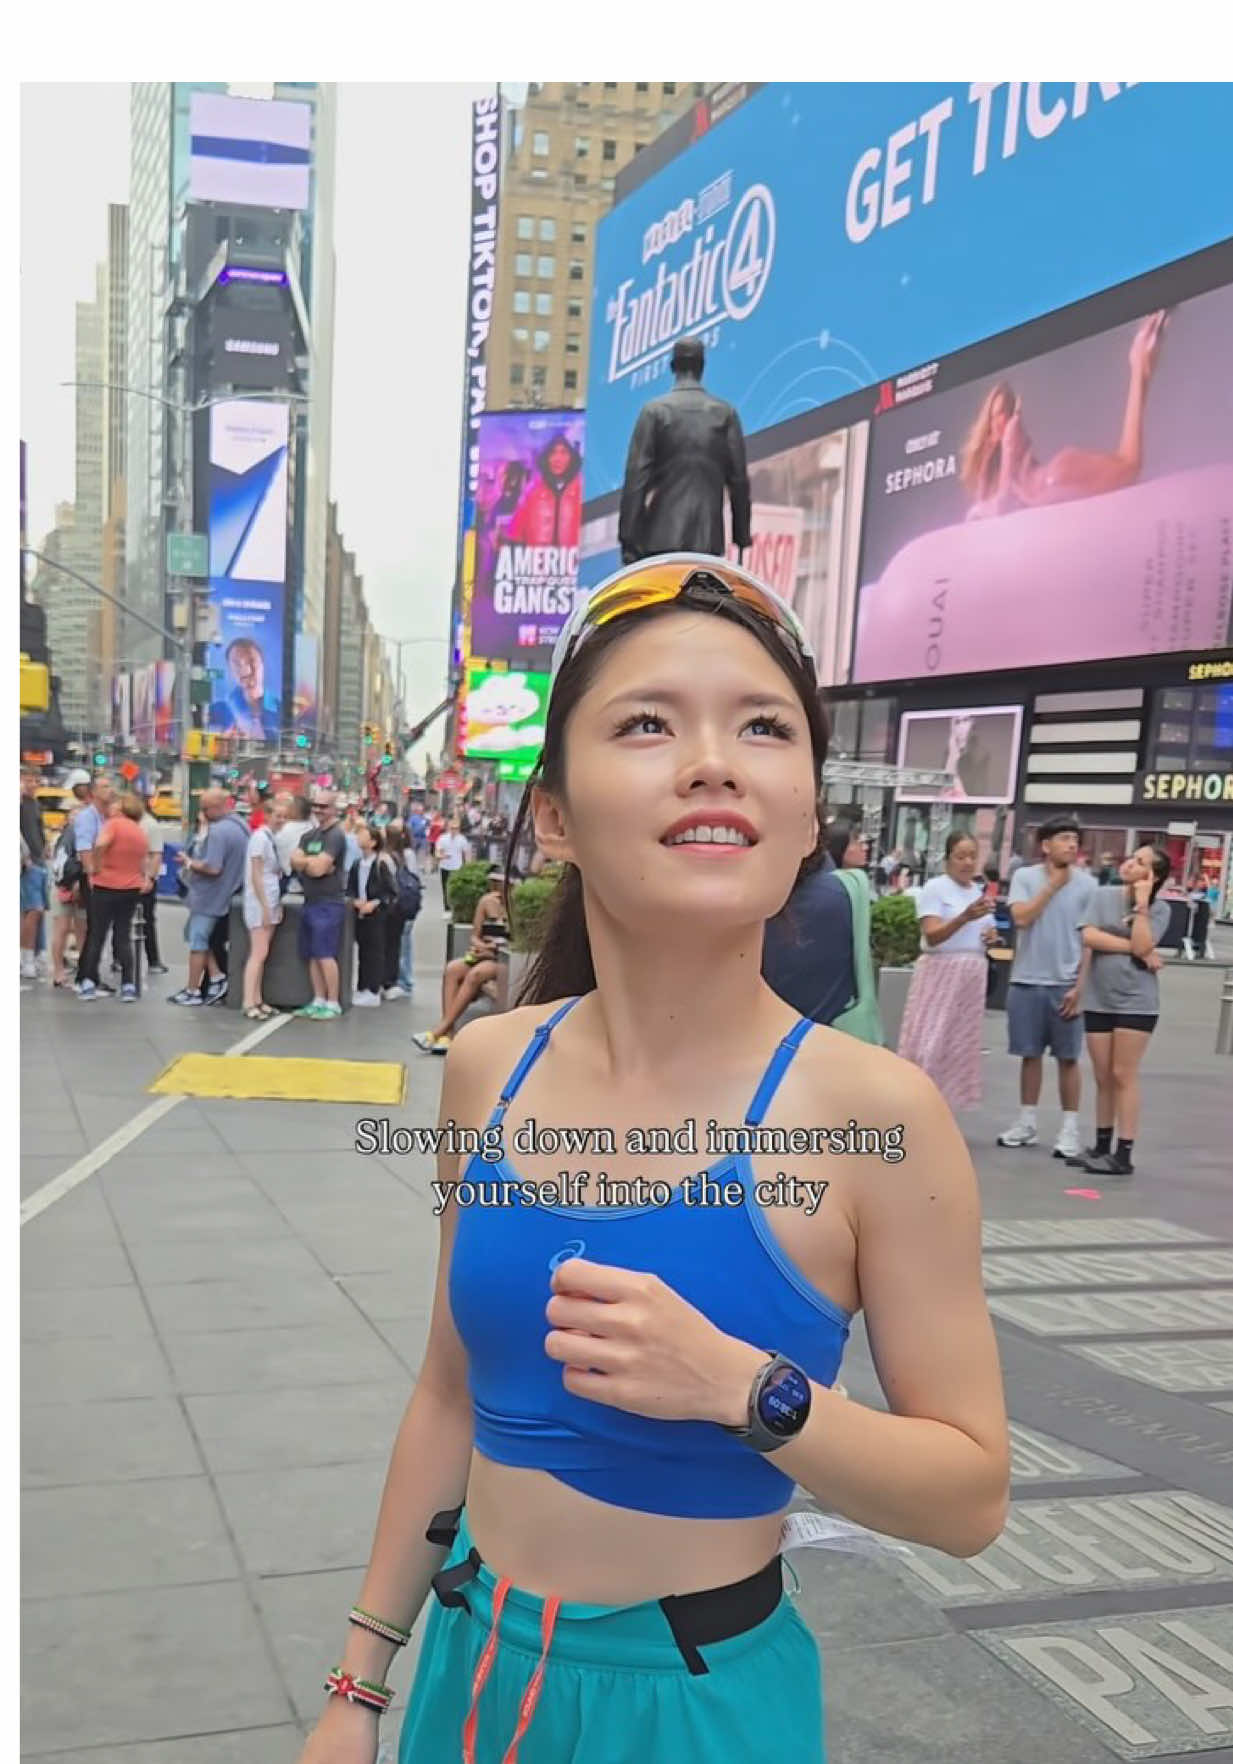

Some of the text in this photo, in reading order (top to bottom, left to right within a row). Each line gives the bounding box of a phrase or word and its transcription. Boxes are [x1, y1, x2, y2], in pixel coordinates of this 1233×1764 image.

[474, 96, 498, 200] SHOP
[845, 97, 954, 244] GET
[608, 226, 726, 383] Fantastic
[885, 454, 956, 494] SEPHORA
[925, 577, 952, 671] OUAI
